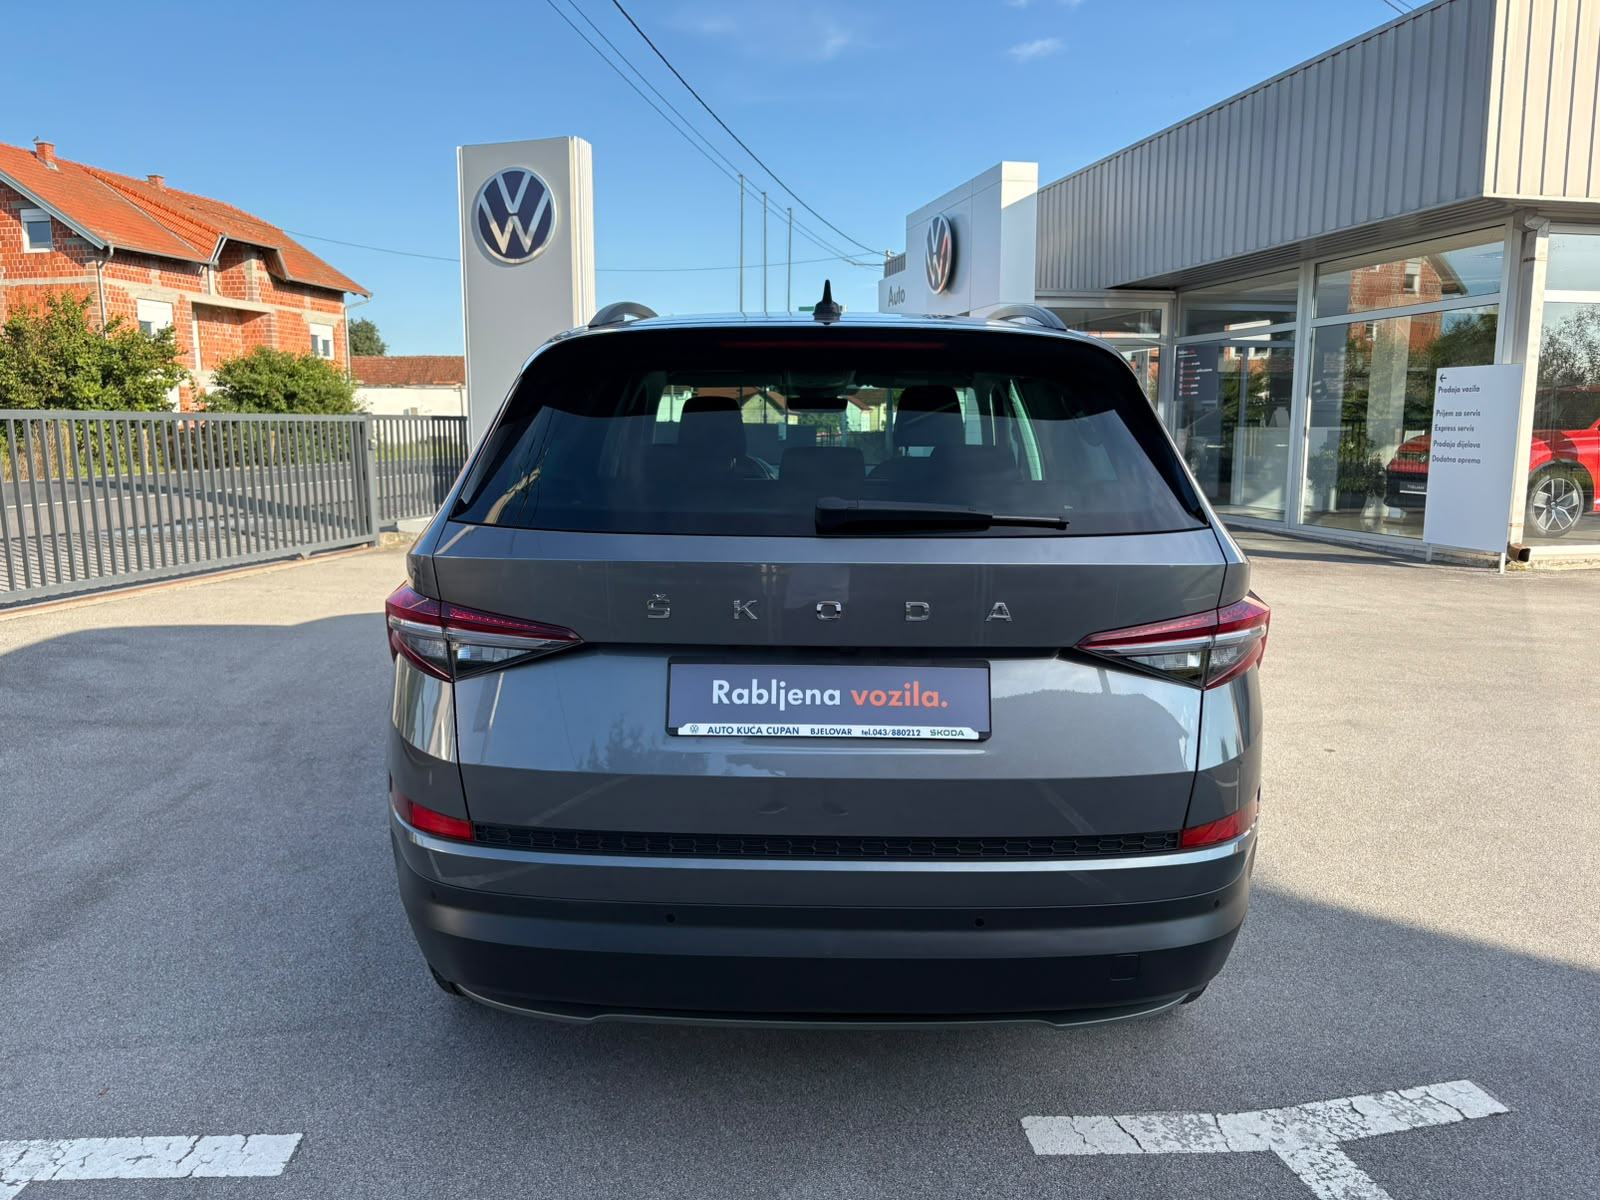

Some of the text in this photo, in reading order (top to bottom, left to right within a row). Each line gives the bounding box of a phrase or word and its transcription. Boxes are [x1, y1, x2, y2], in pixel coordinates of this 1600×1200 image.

[888, 286, 905, 307] Auto
[1438, 386, 1460, 394] Prodaja
[1436, 409, 1454, 418] Prijem
[1434, 424, 1456, 432] Express
[1433, 440, 1480, 449] Prodaja dijelova
[1432, 455, 1456, 463] Dodatna
[712, 679, 949, 711] Rabljena vozila.
[707, 726, 734, 735] AUTO
[810, 727, 852, 735] BJELOVAR
[861, 729, 921, 737] tel.043/880212
